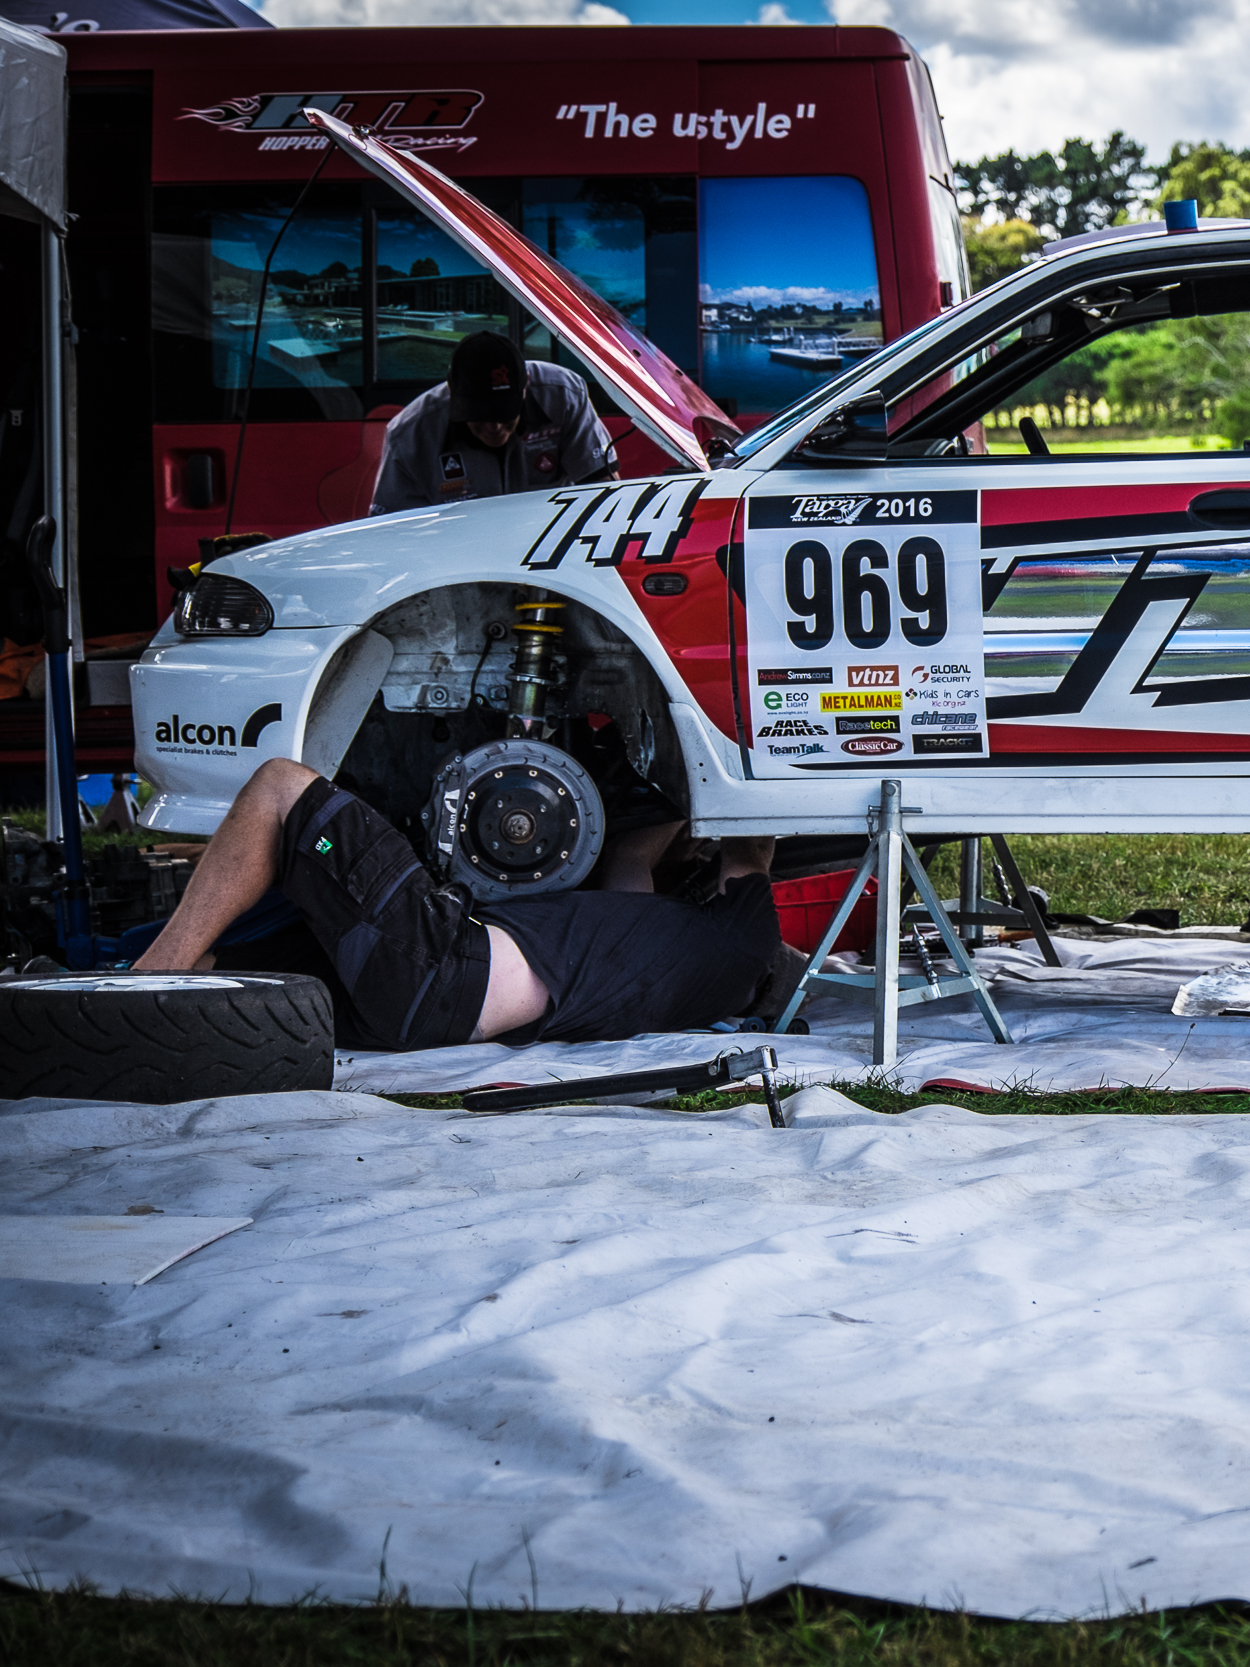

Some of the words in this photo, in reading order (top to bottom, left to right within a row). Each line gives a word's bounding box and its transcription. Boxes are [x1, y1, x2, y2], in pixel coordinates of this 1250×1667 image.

[875, 497, 933, 518] 2016
[520, 477, 712, 571] 744
[784, 535, 949, 651] 969
[851, 668, 896, 685] vtnz
[930, 665, 971, 674] GLOBAL
[786, 692, 809, 701] ECO
[919, 690, 939, 699] Kids
[944, 689, 951, 699] in
[957, 689, 979, 698] Cars
[822, 695, 892, 710] METALMAN
[774, 719, 812, 728] RACE
[911, 711, 977, 725] chicane
[155, 714, 236, 746] alcon
[757, 725, 829, 737] BRAKES
[767, 743, 824, 755] TeamTalk
